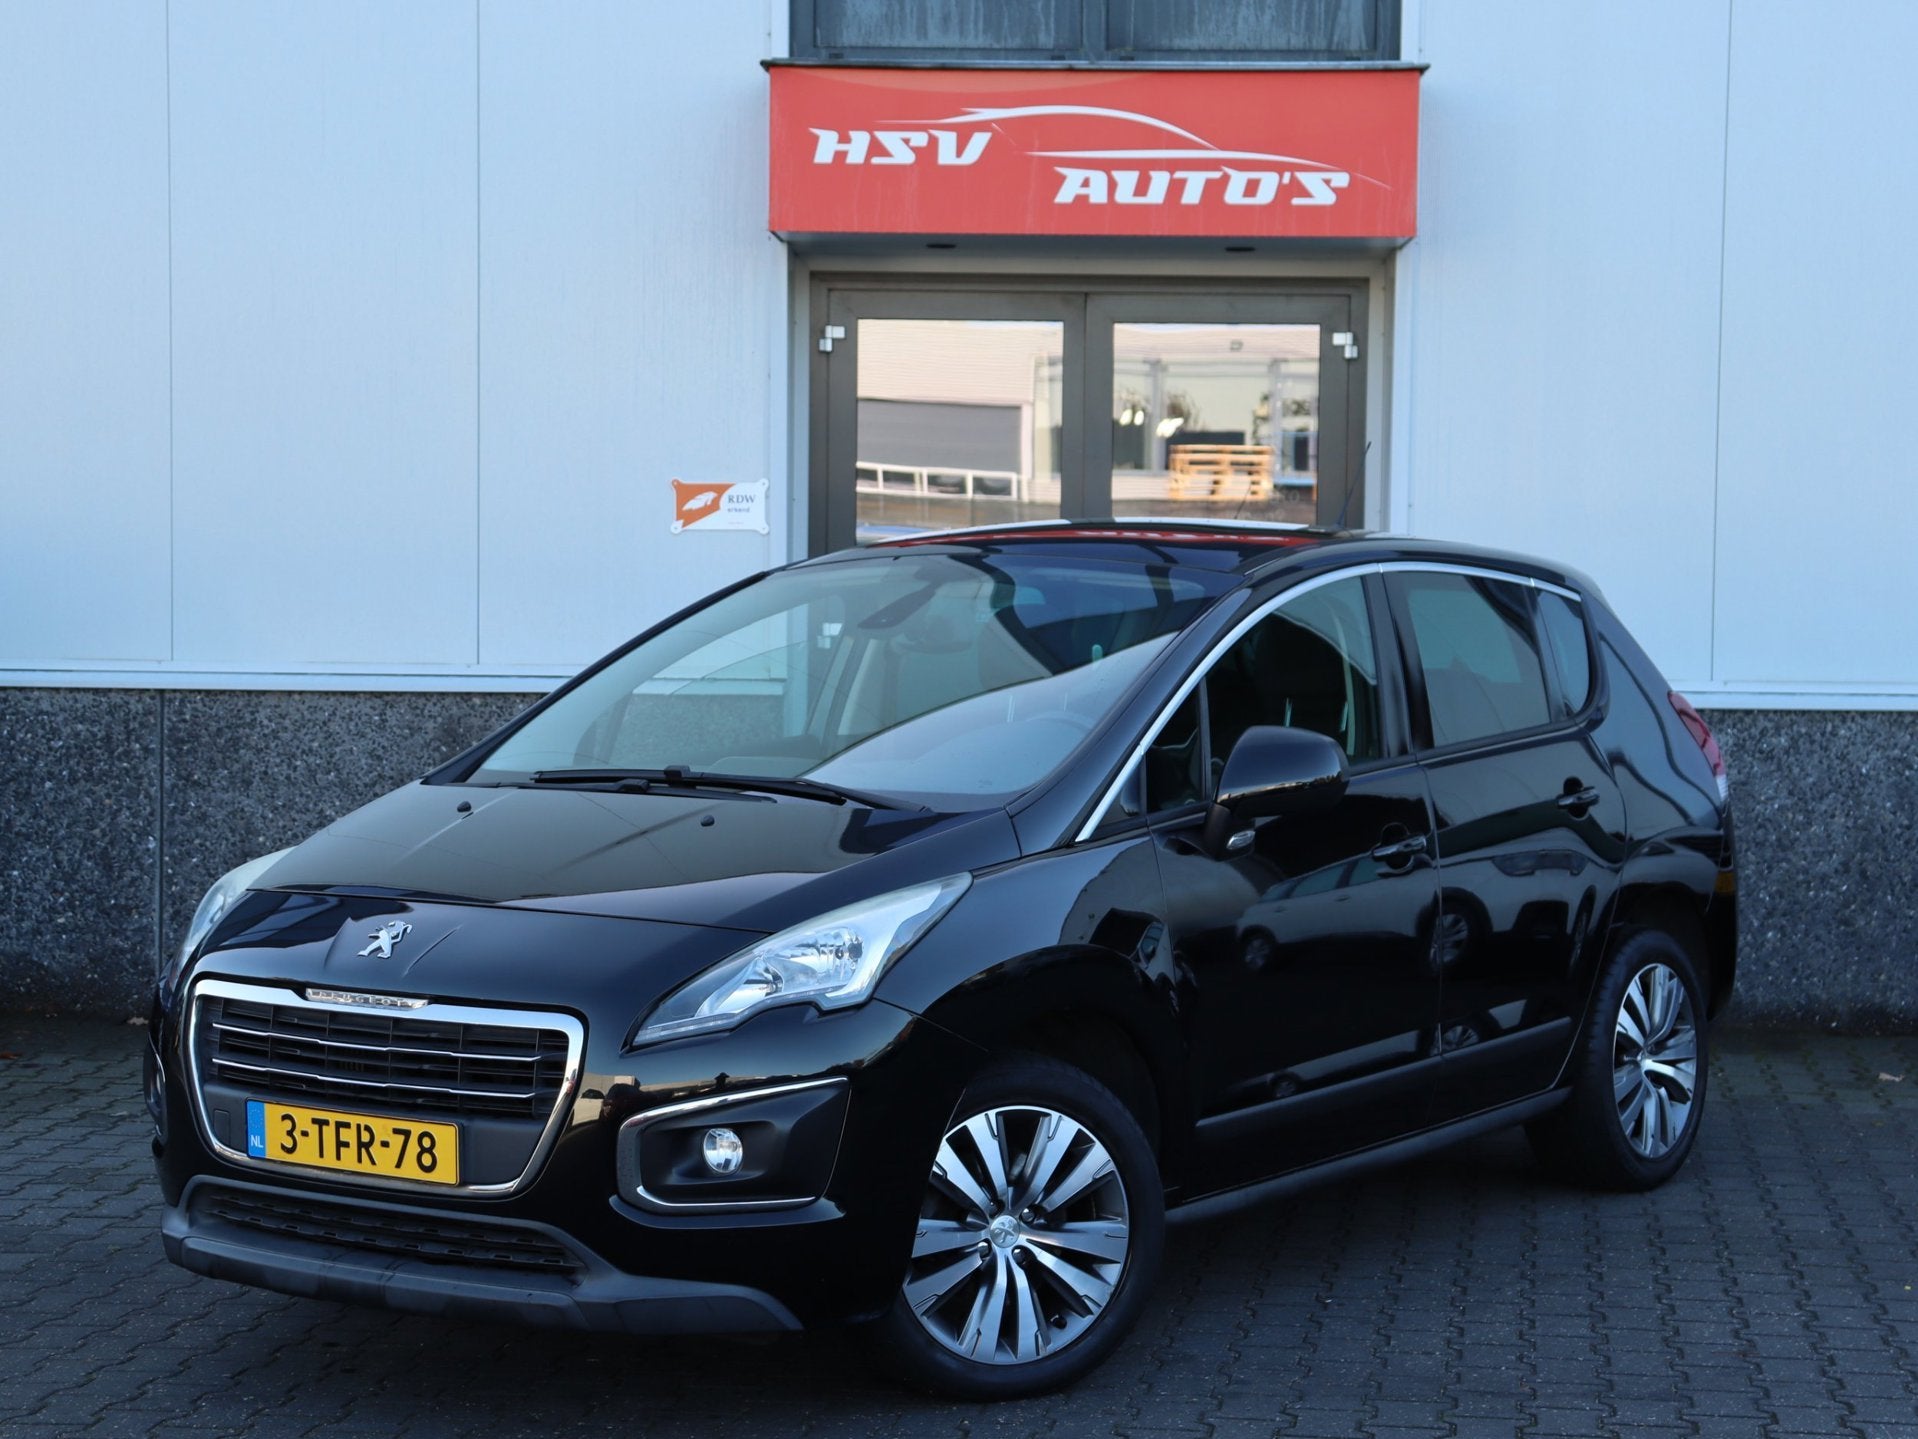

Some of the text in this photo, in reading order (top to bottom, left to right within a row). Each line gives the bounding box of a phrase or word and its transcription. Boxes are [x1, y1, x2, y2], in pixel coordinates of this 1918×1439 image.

[808, 128, 993, 166] HSV
[1054, 166, 1351, 206] AUTO'S
[728, 494, 755, 504] RDW
[250, 1113, 438, 1173] NL 3-TFR-78
